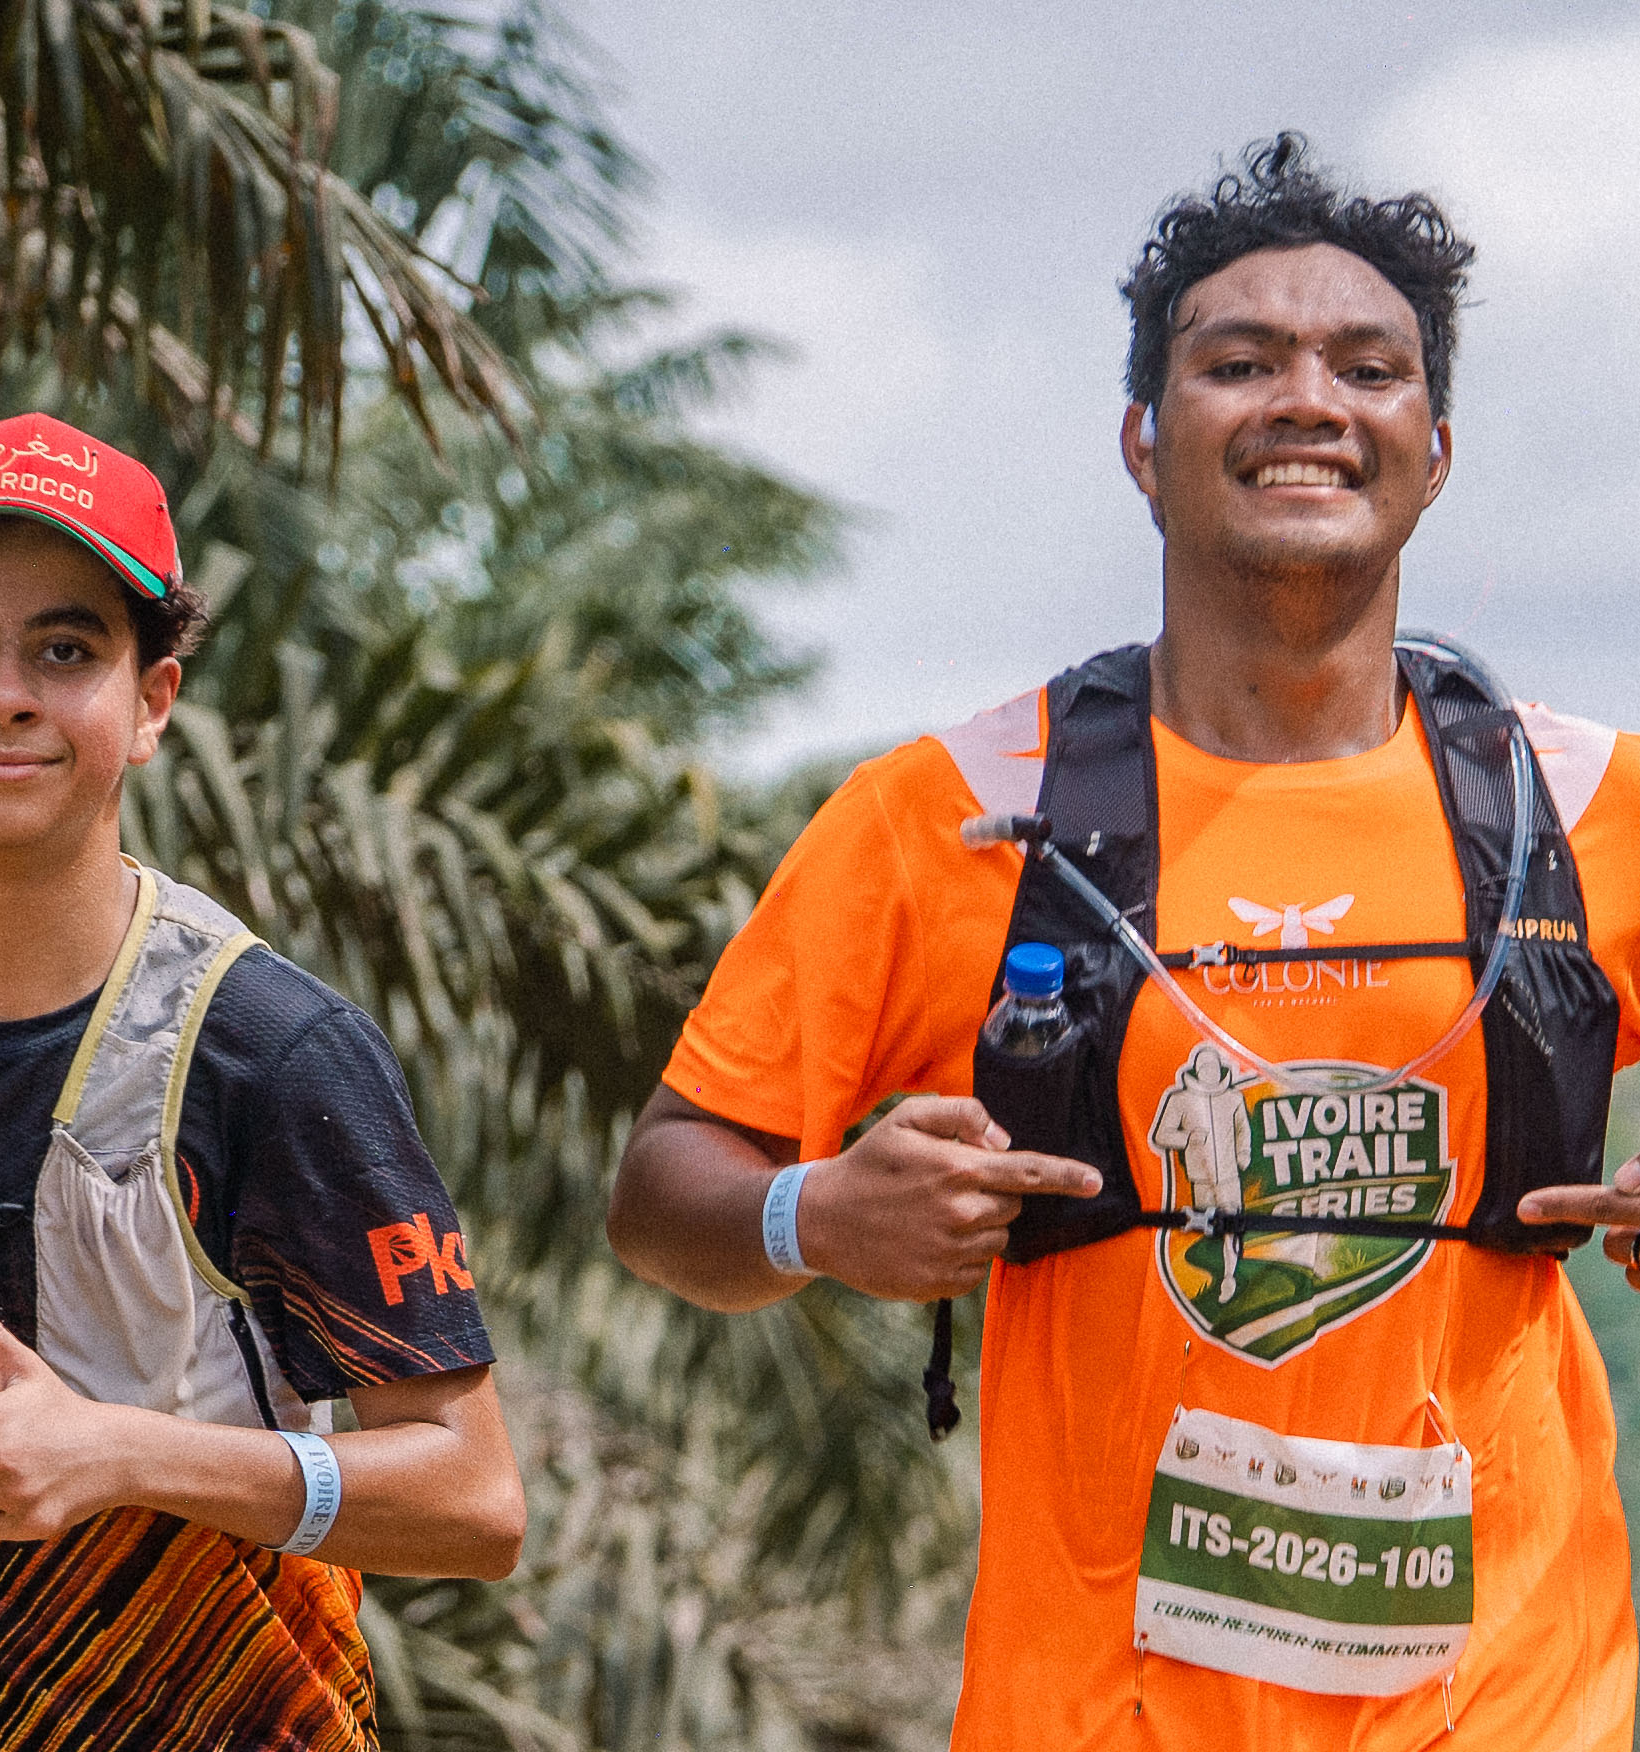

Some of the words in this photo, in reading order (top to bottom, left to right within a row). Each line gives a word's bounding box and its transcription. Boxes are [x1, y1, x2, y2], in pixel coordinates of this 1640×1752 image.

[1513, 917, 1578, 943] IPRUN
[1262, 1091, 1426, 1141] IVOIRE
[1262, 1132, 1427, 1187] TRAIL
[308, 1451, 335, 1525] IVOIRE
[1169, 1502, 1455, 1590] ITS-2026-106
